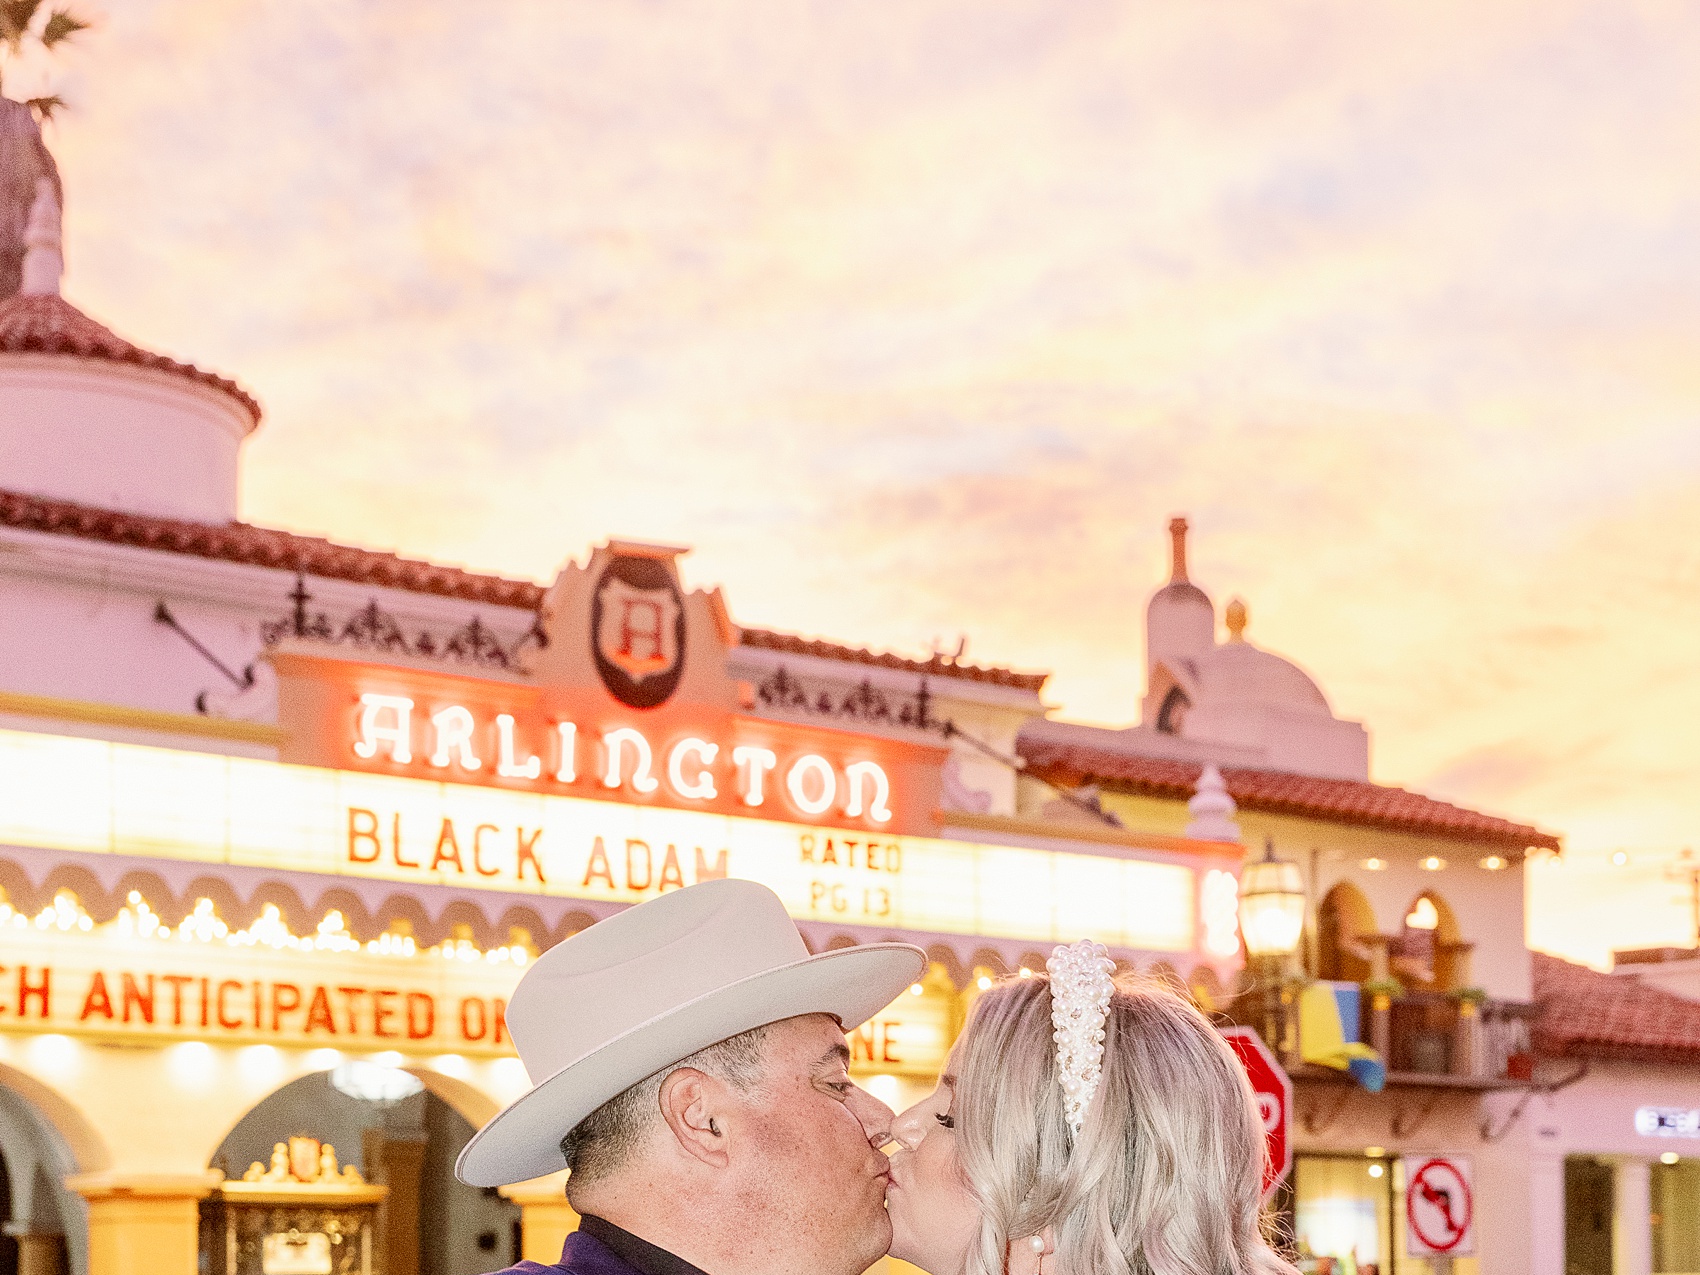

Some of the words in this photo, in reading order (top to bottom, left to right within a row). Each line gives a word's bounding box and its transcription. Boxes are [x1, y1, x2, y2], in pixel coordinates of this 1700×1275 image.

[354, 693, 893, 823] ARLINGTON
[348, 807, 547, 882] BLACK
[582, 836, 728, 892] ADAM
[800, 834, 901, 873] RATED
[811, 881, 848, 913] PG
[863, 888, 890, 917] 13
[0, 965, 50, 1018] H
[80, 971, 435, 1040] ANTICIPATED
